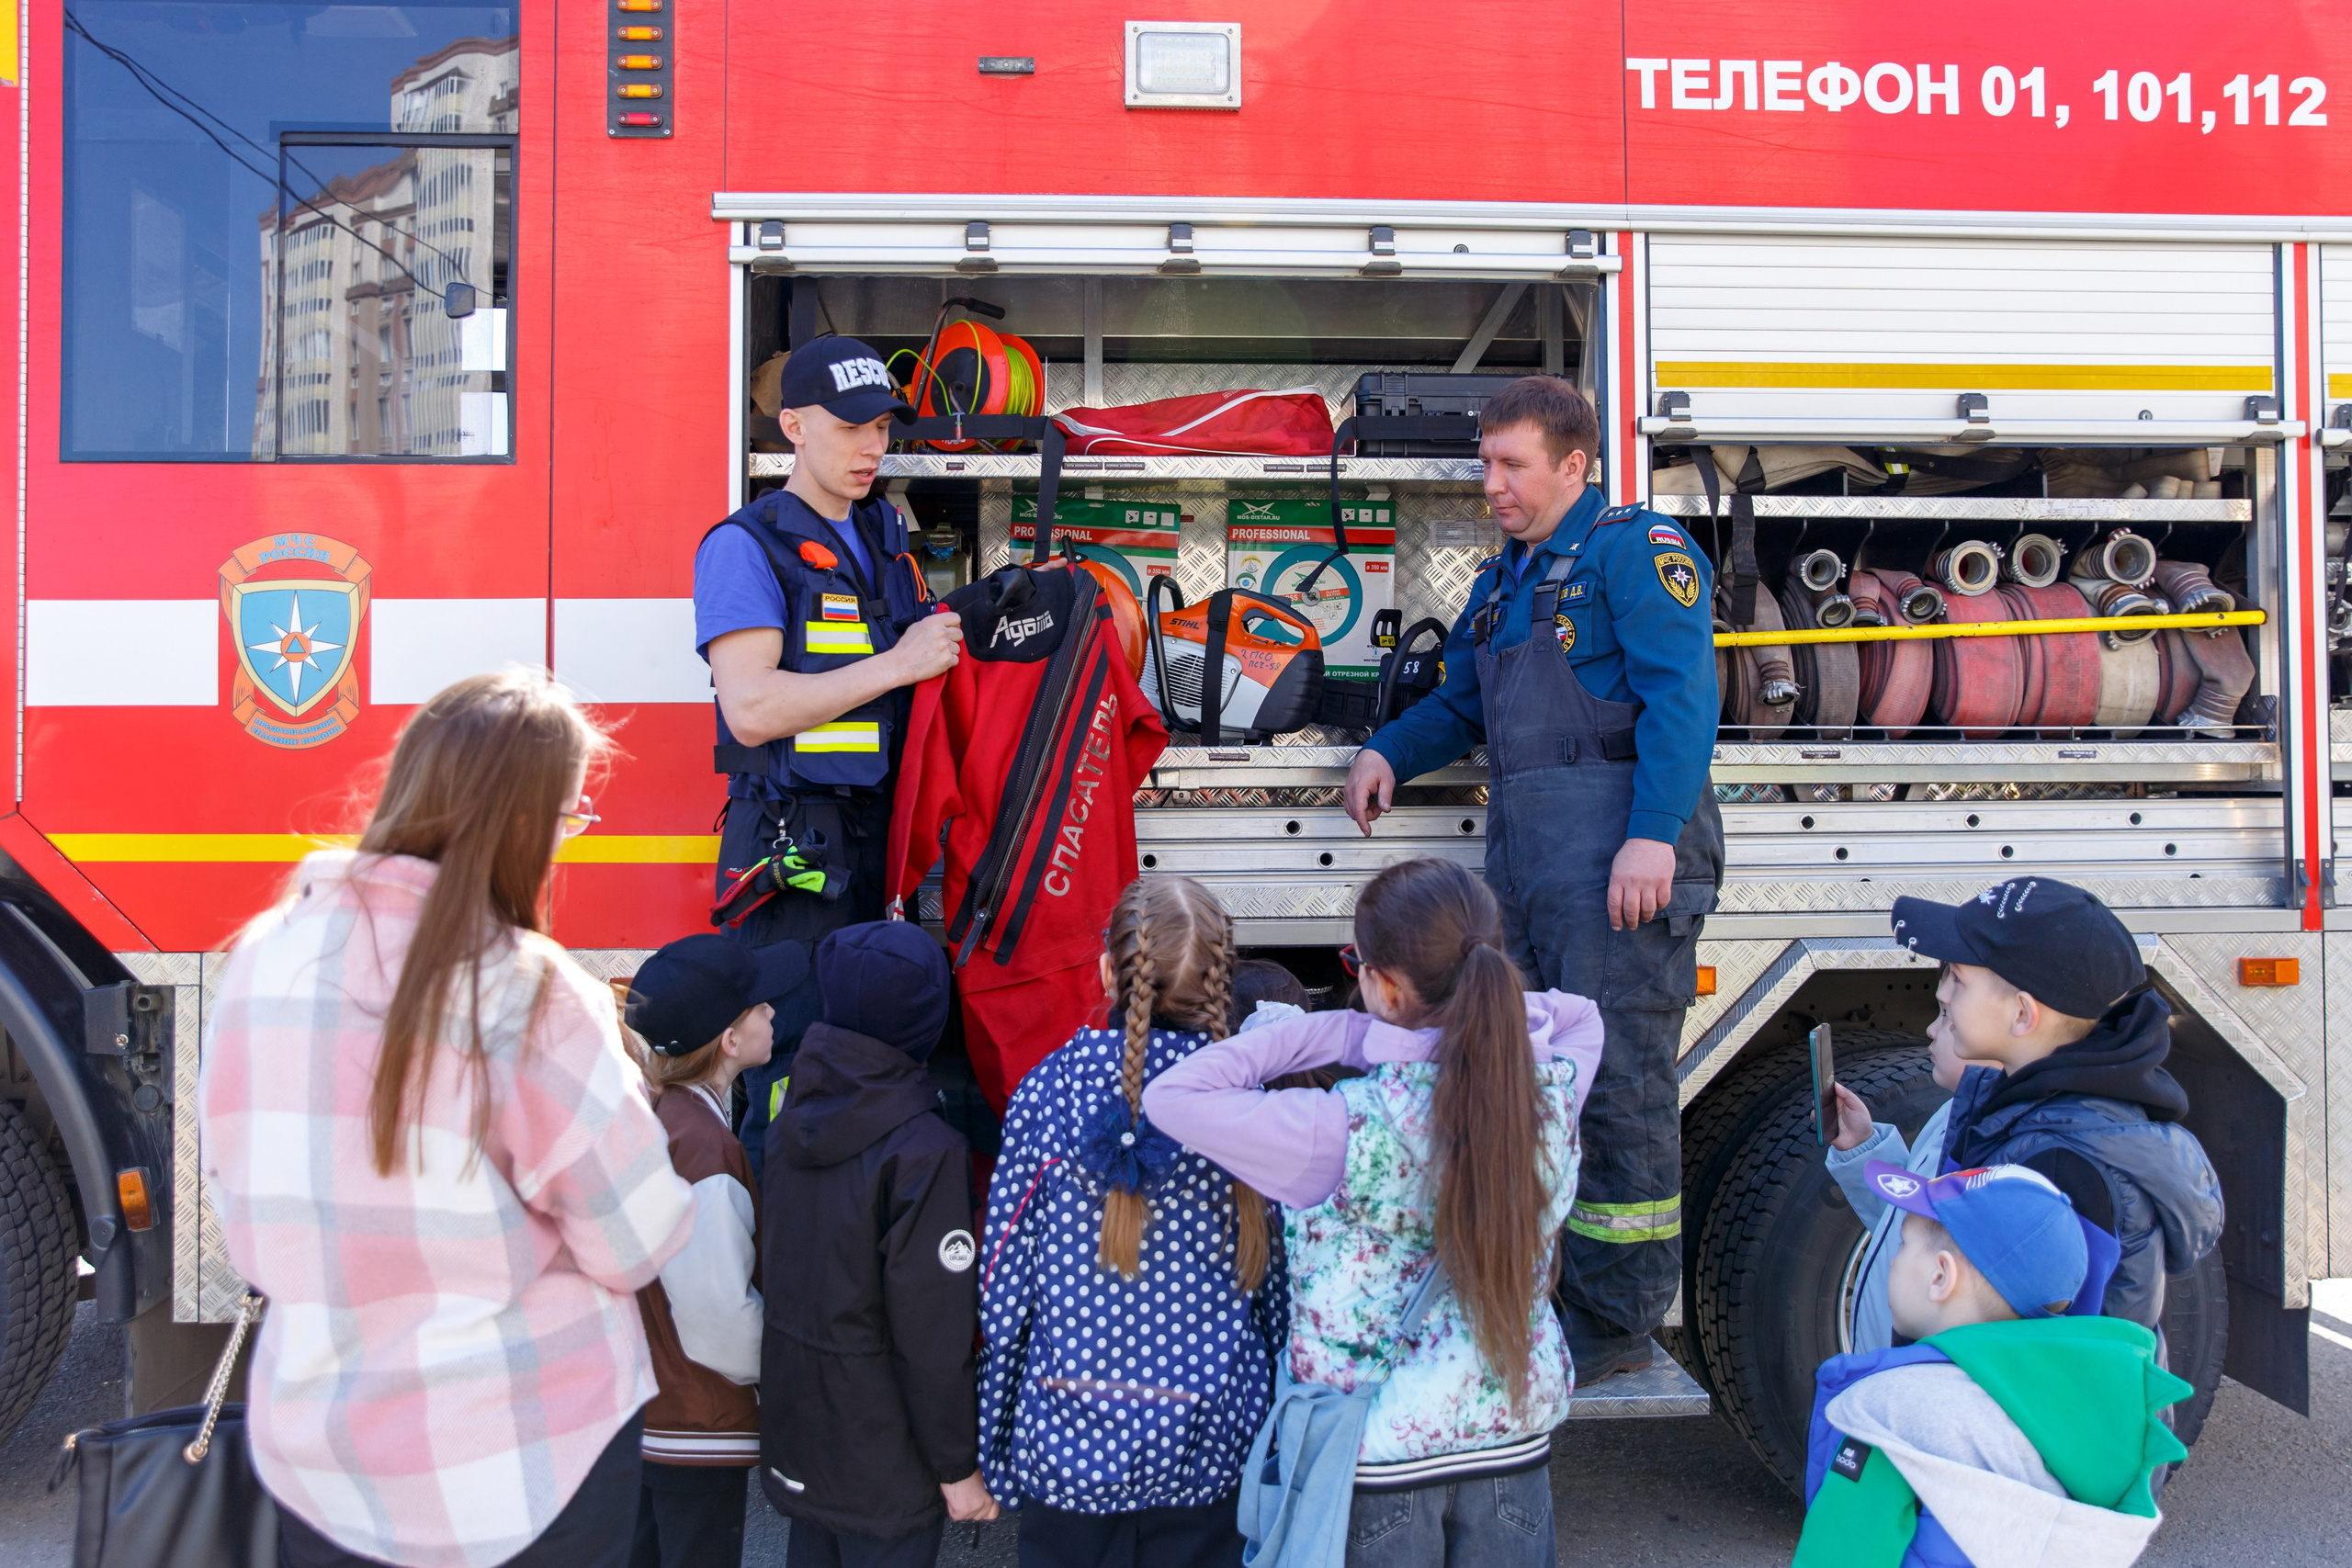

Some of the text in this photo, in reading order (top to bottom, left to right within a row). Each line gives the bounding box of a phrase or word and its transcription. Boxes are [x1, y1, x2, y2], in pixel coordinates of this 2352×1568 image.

[1626, 57, 1960, 116] ТЕЛЕФОН
[1981, 66, 2070, 129] 01,
[829, 356, 891, 393] RESCU
[274, 535, 316, 547] МЧС
[1013, 525, 1092, 541] PROSIONAL
[1232, 528, 1310, 540] PROFESSIONAL
[1655, 536, 1682, 547] RUSSIA
[258, 547, 331, 564] РОССИИ
[824, 595, 856, 604] РОССИЯ
[1170, 617, 1200, 630] STIHL
[1331, 670, 1370, 678] ОТРЕЗНОЙ
[254, 716, 337, 736] ПРЕДОТВРАЩЕНИЕ
[250, 724, 343, 746] СПАСЕНИЕ ПОМОЩЬ
[1044, 692, 1119, 897] СПАСАТЕЛЬ
[1836, 1453, 1856, 1470] bodo
